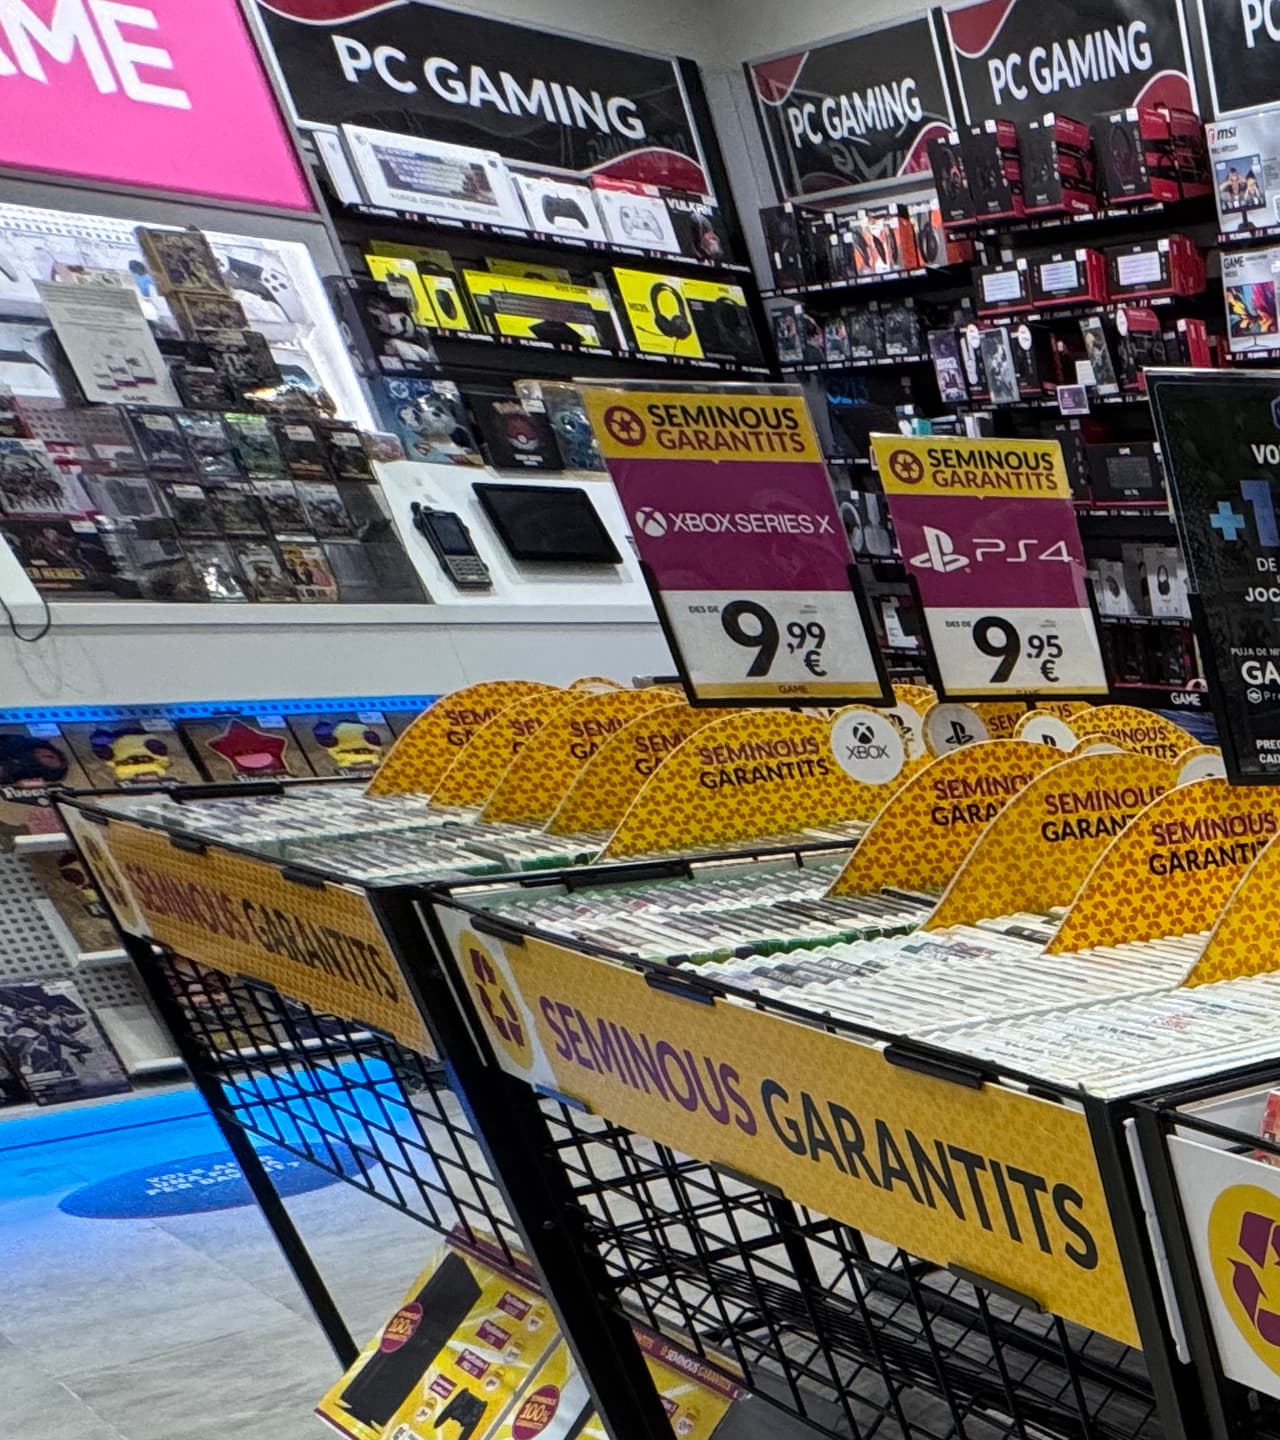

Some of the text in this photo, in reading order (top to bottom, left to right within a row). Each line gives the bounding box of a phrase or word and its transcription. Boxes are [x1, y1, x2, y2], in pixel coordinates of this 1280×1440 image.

[989, 21, 1152, 103] PC GAMING
[331, 34, 648, 139] PC GAMING
[791, 78, 922, 149] PC GAMING
[648, 405, 798, 430] SEMINOUS
[656, 429, 805, 454] GARANTITS
[928, 448, 1055, 471] SEMINOUS
[933, 470, 1057, 490] GARANTITS
[672, 514, 835, 534] XBOX SERIES X
[973, 539, 1077, 563] PS4
[1257, 557, 1277, 571] DE
[1256, 648, 1268, 656] DE
[700, 737, 820, 764] SEMINOUS
[848, 743, 889, 759] XBOX
[699, 759, 830, 789] GARANTITS
[1044, 785, 1167, 815] SEMINOUS
[1151, 812, 1278, 846] SEMINOUS
[241, 899, 399, 1001] GARANTITS
[539, 995, 1100, 1270] SEMINOUS GARANTITS
